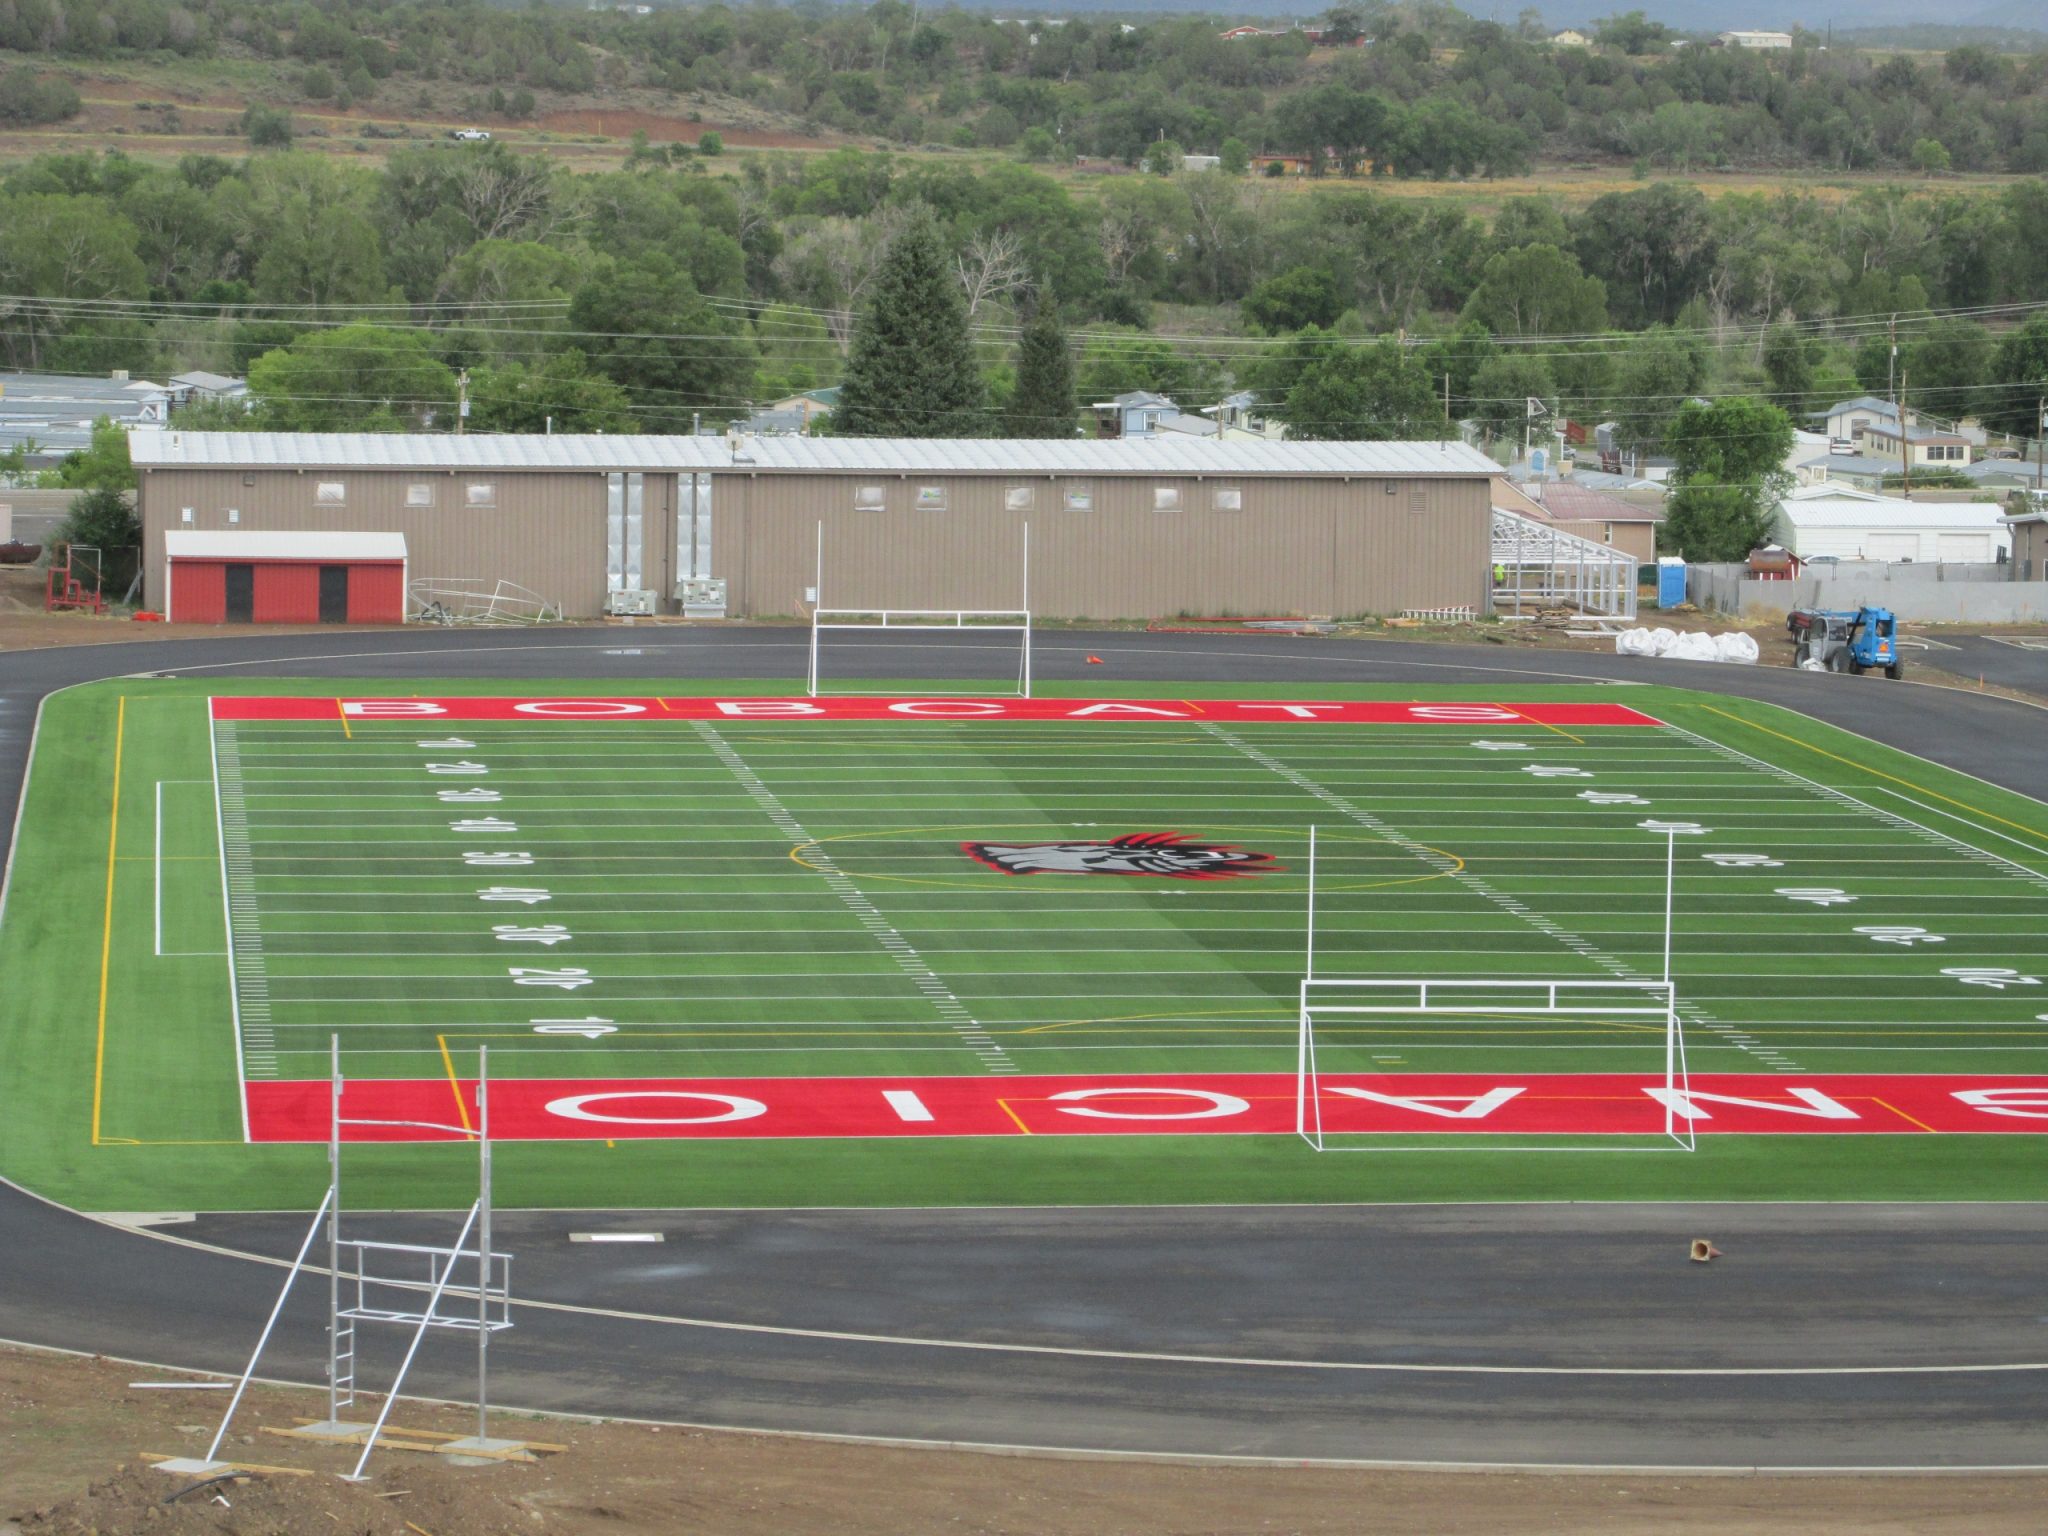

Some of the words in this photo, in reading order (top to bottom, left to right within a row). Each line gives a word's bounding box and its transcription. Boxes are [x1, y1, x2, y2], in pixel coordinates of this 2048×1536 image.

[342, 701, 1521, 720] BOBCATS
[425, 763, 489, 774] 20
[436, 790, 503, 802] 30
[448, 819, 518, 832] 40
[462, 852, 535, 865] 50
[1701, 854, 1785, 867] 50
[476, 886, 552, 901] 40
[1773, 888, 1860, 903] 40
[491, 925, 573, 941] 30
[1852, 926, 1946, 942] 30
[508, 967, 594, 985] 20
[1939, 967, 2044, 985] 20
[529, 1016, 619, 1033] 10
